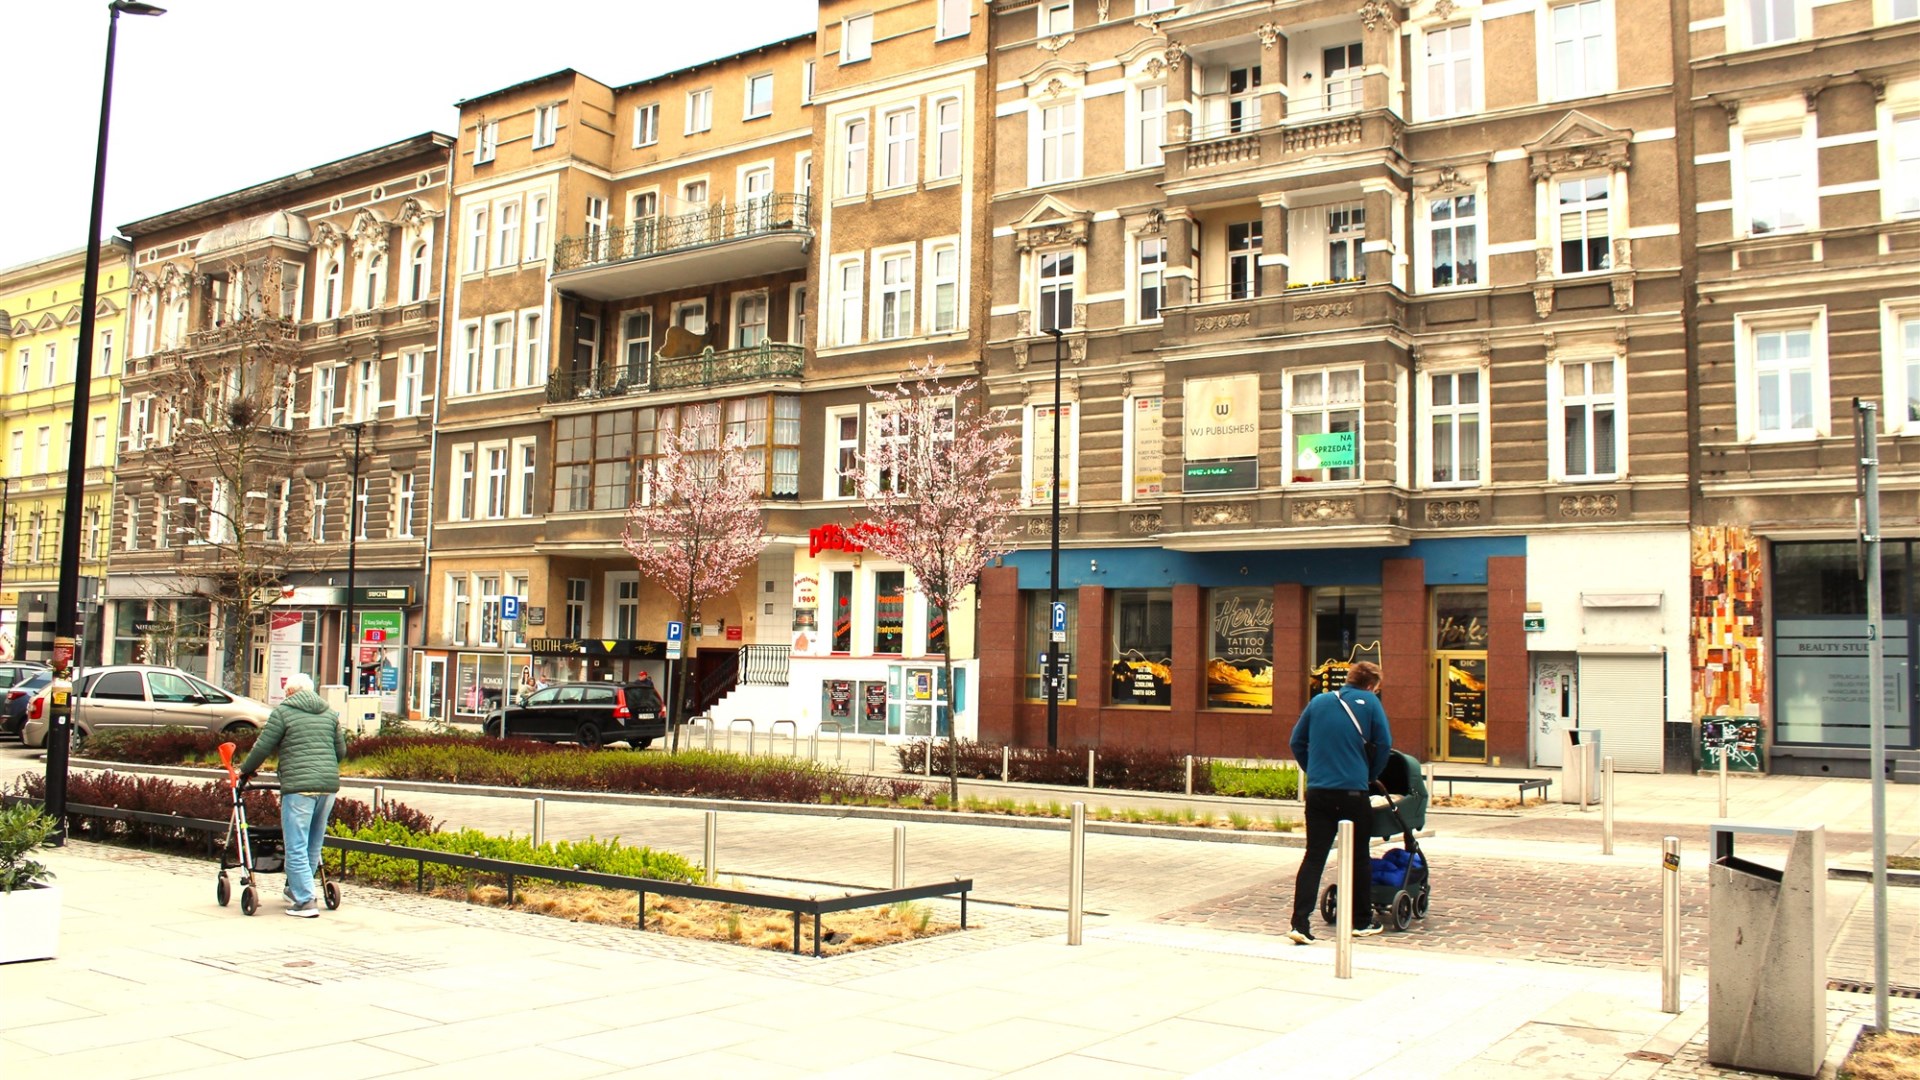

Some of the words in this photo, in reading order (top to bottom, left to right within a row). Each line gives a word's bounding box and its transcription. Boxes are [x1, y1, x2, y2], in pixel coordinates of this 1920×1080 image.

[1190, 427, 1204, 437] WJ
[1206, 424, 1255, 436] PUBLISHERS
[1340, 434, 1352, 442] NA
[1314, 443, 1352, 454] SPRZEDAŻ
[505, 598, 515, 617] P
[1056, 610, 1064, 628] P
[670, 624, 679, 639] P
[532, 640, 561, 652] BUTIK
[1227, 637, 1265, 646] TATTOO
[1227, 647, 1263, 655] STUDIO
[1799, 643, 1840, 652] BEAUTY
